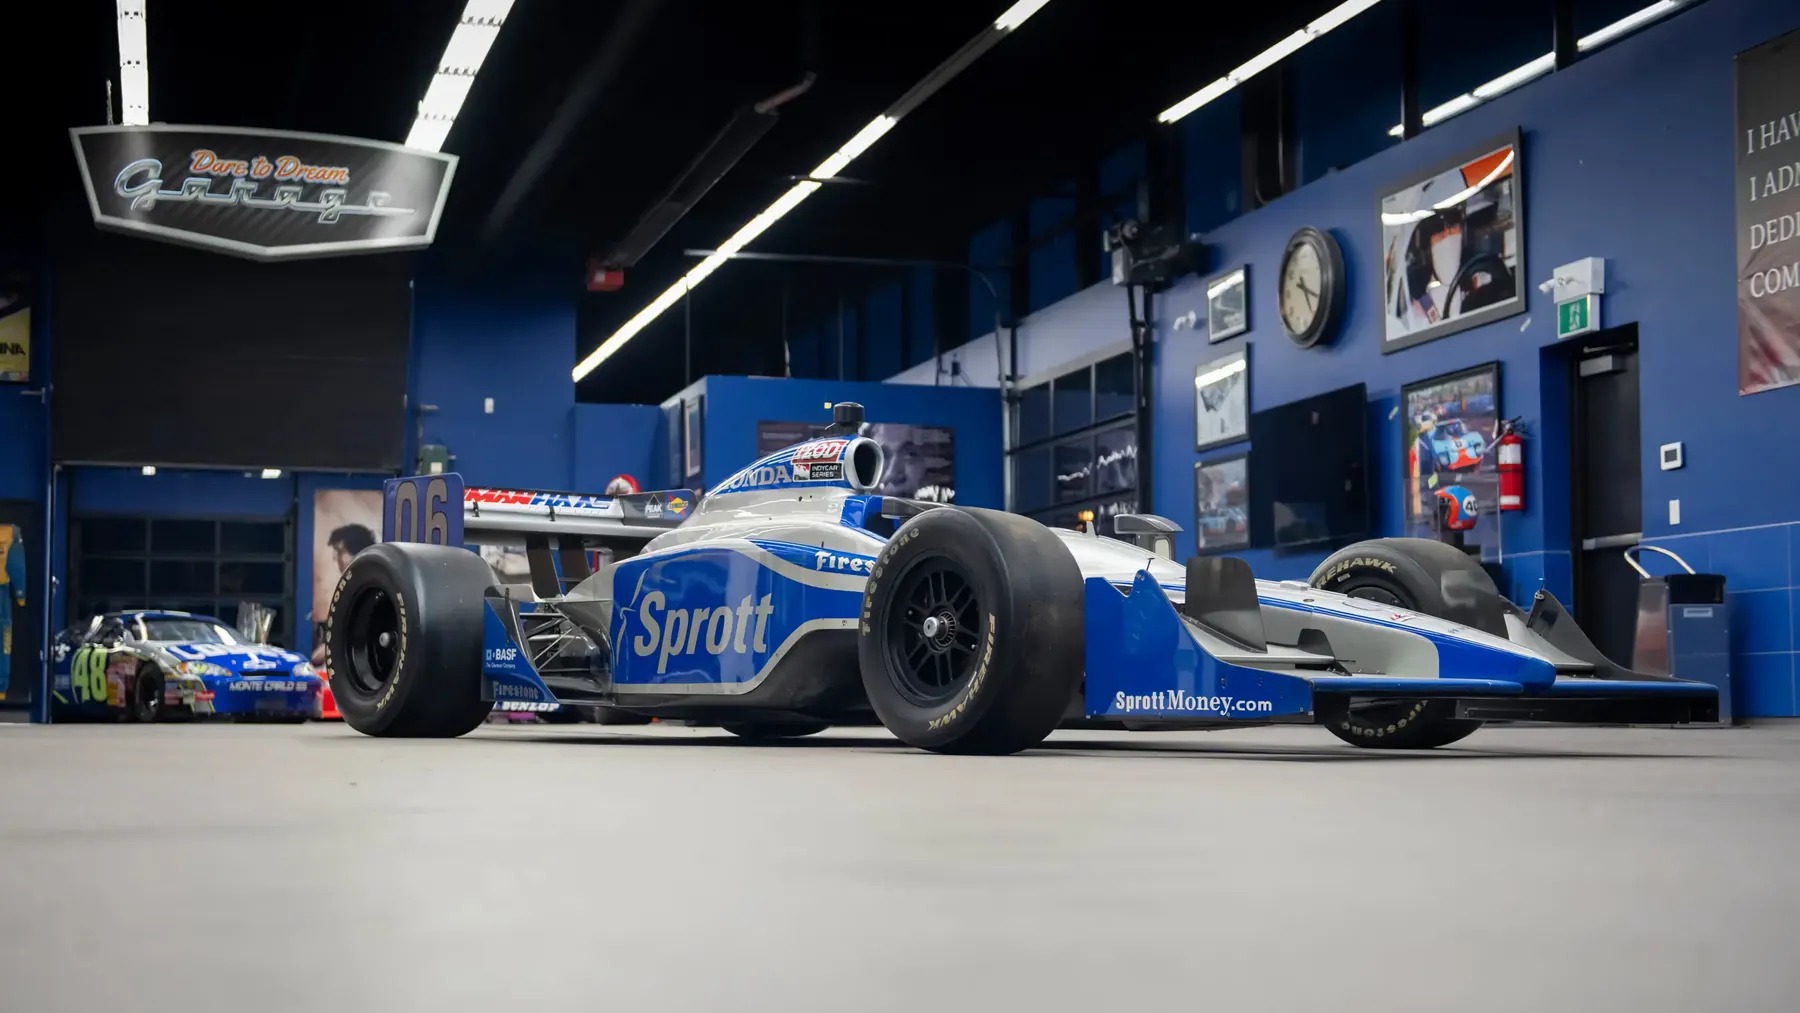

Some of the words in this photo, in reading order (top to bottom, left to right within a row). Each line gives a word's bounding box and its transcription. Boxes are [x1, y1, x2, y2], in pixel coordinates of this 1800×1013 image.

[1747, 128, 1754, 155] I
[191, 149, 248, 177] Dare
[252, 155, 273, 178] to
[276, 155, 350, 184] Dream
[114, 158, 416, 224] Garage
[1750, 176, 1757, 202] I
[794, 442, 843, 459] IZOD
[395, 478, 447, 546] 06
[634, 590, 774, 674] Sprott
[495, 648, 517, 661] BASF
[71, 647, 108, 703] 48
[927, 612, 996, 731] FIREHAWK
[229, 680, 262, 692] MONTE
[263, 680, 294, 692] CARLO
[493, 681, 539, 700] Firestone
[502, 700, 560, 712] DUNLOP
